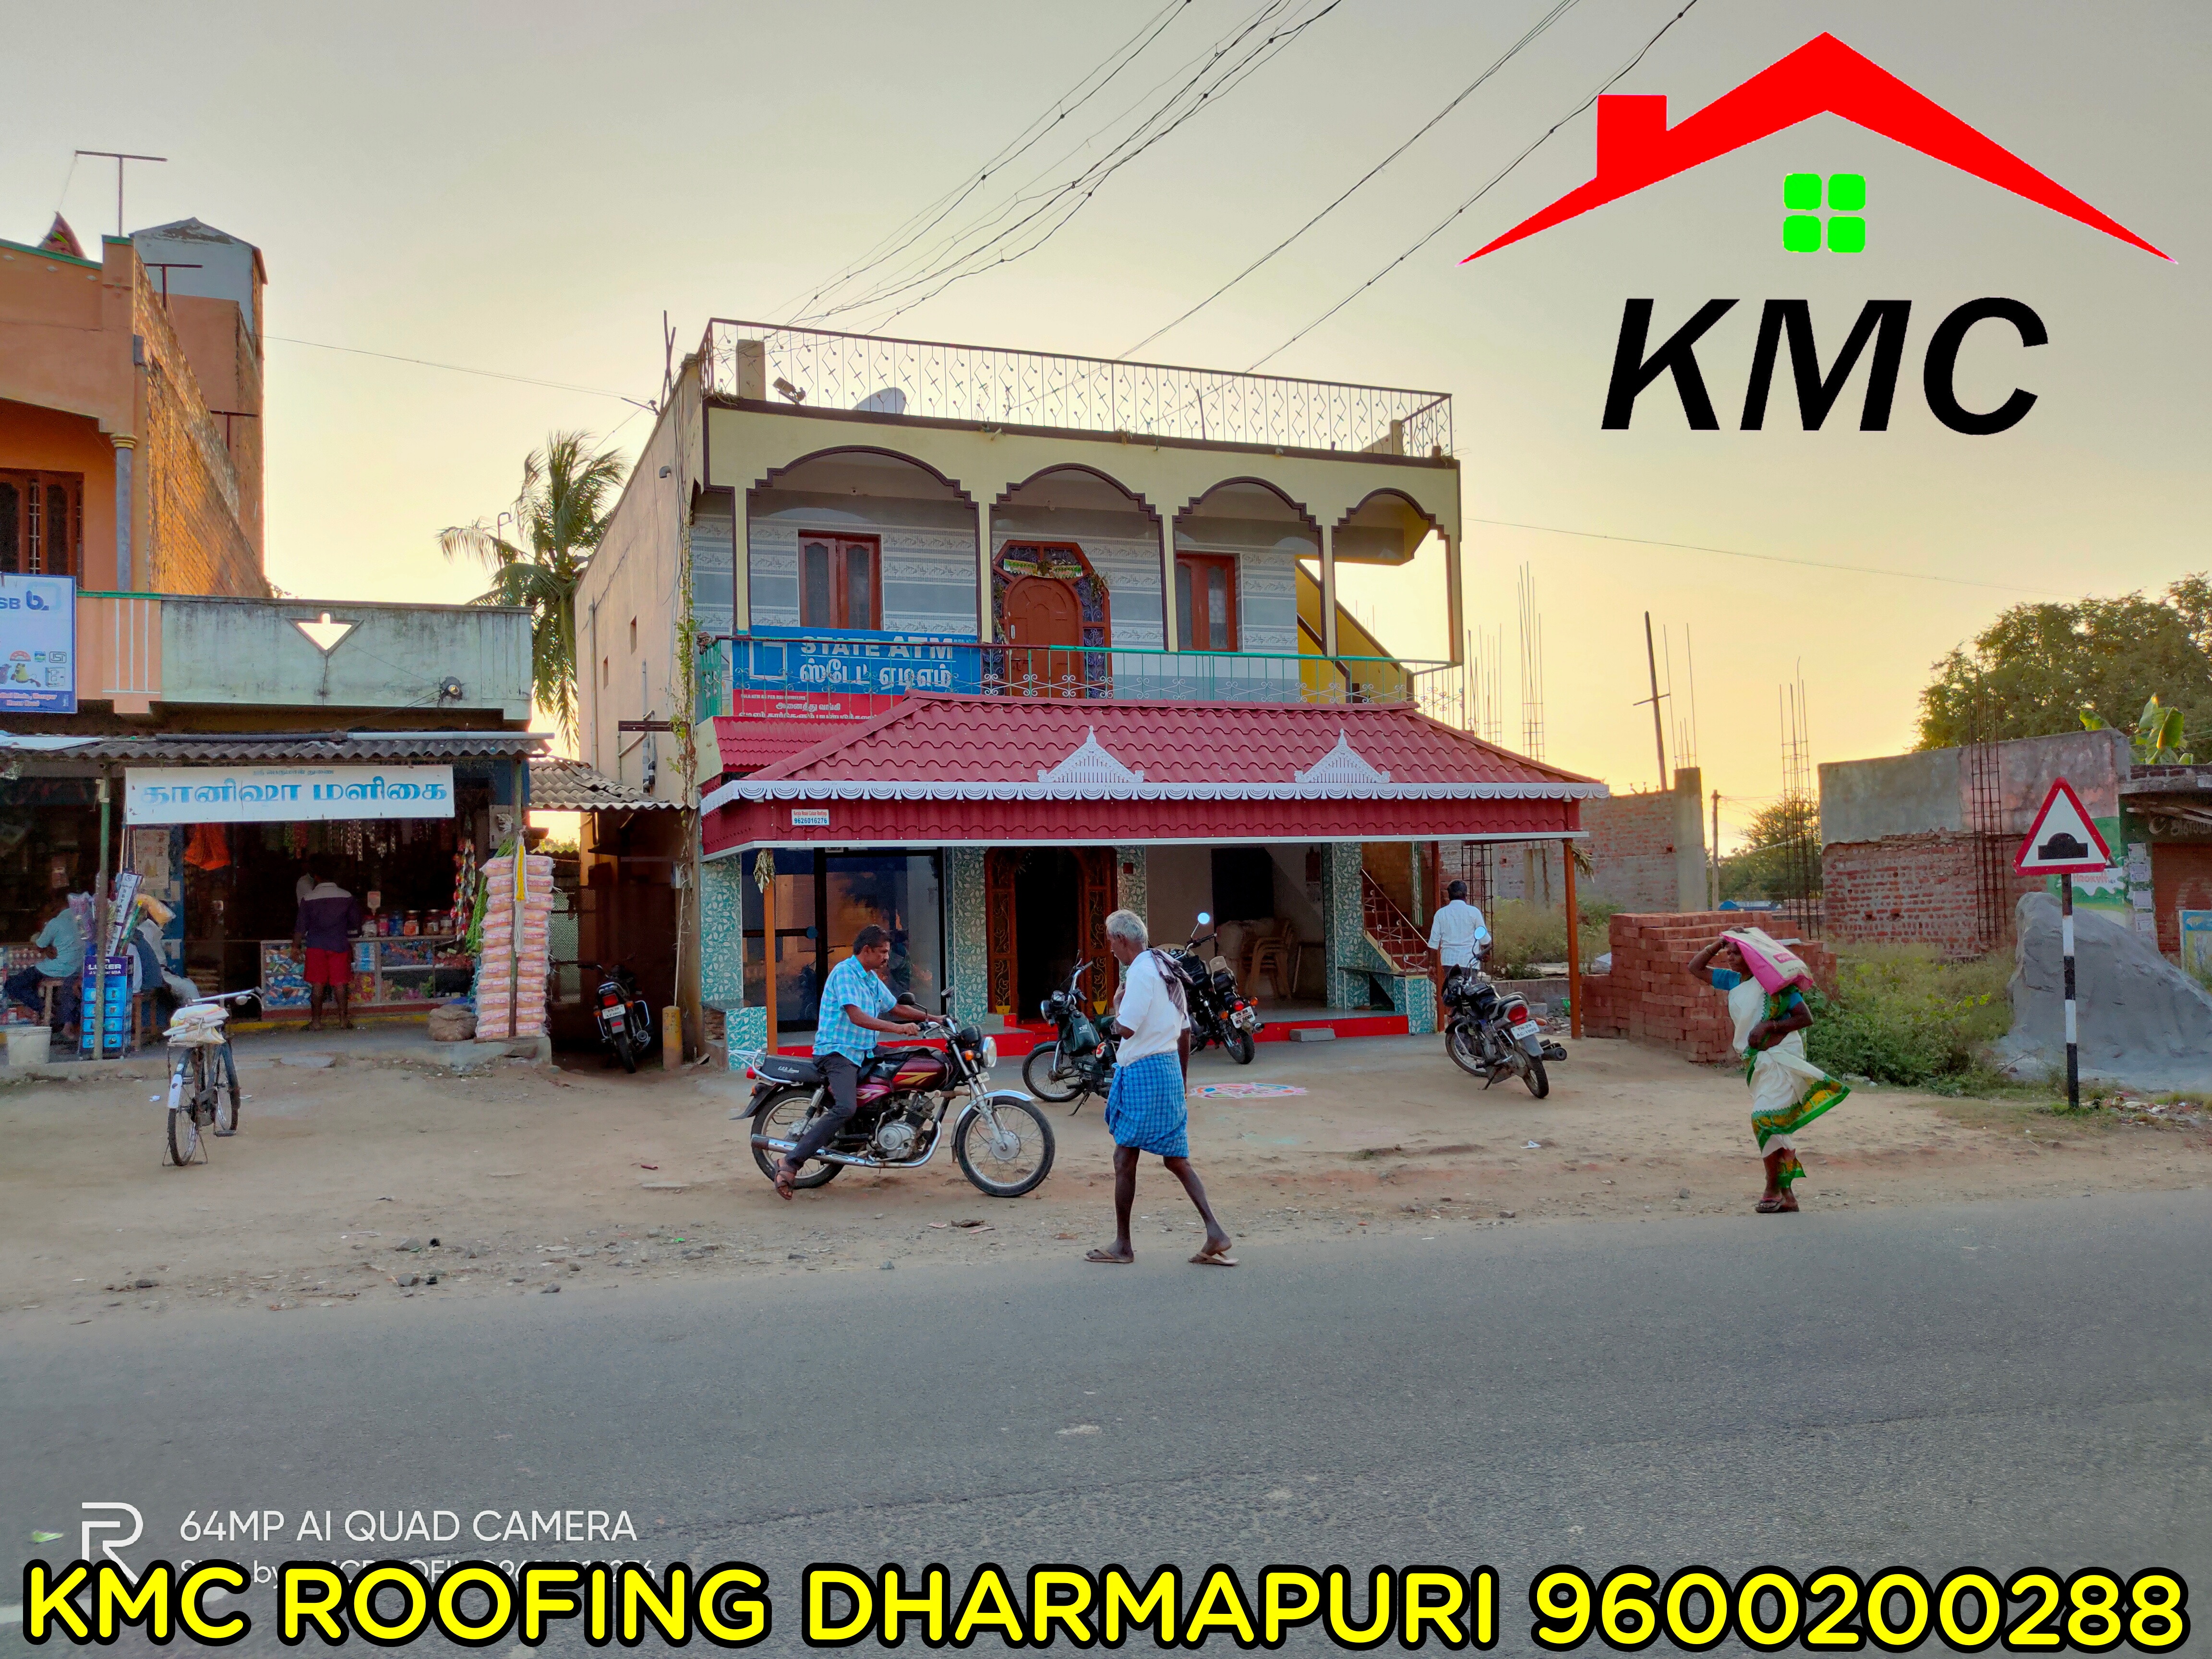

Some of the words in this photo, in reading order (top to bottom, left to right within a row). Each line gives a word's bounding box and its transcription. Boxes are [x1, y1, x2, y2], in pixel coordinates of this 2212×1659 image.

[800, 636, 880, 657] STATE
[889, 636, 953, 660] ATM
[313, 776, 447, 801] மளிகை
